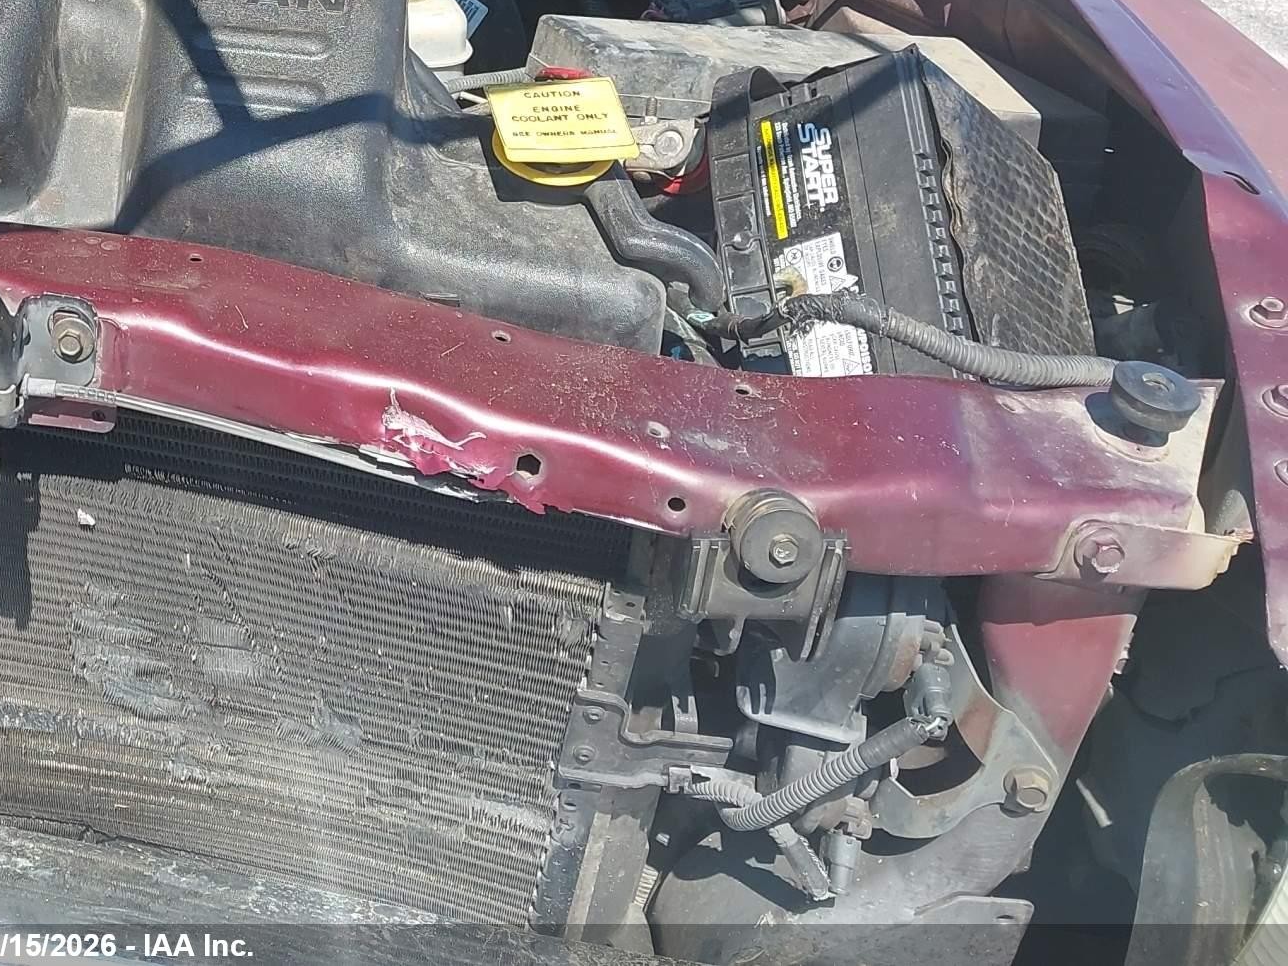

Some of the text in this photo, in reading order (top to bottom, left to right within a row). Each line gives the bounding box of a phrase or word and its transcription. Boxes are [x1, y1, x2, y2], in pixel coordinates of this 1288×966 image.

[523, 89, 581, 99] CAUTION
[532, 105, 581, 113] ENGINE
[512, 113, 609, 123] COOLANT ONLY
[797, 122, 826, 208] START
[815, 127, 839, 204] SUPER
